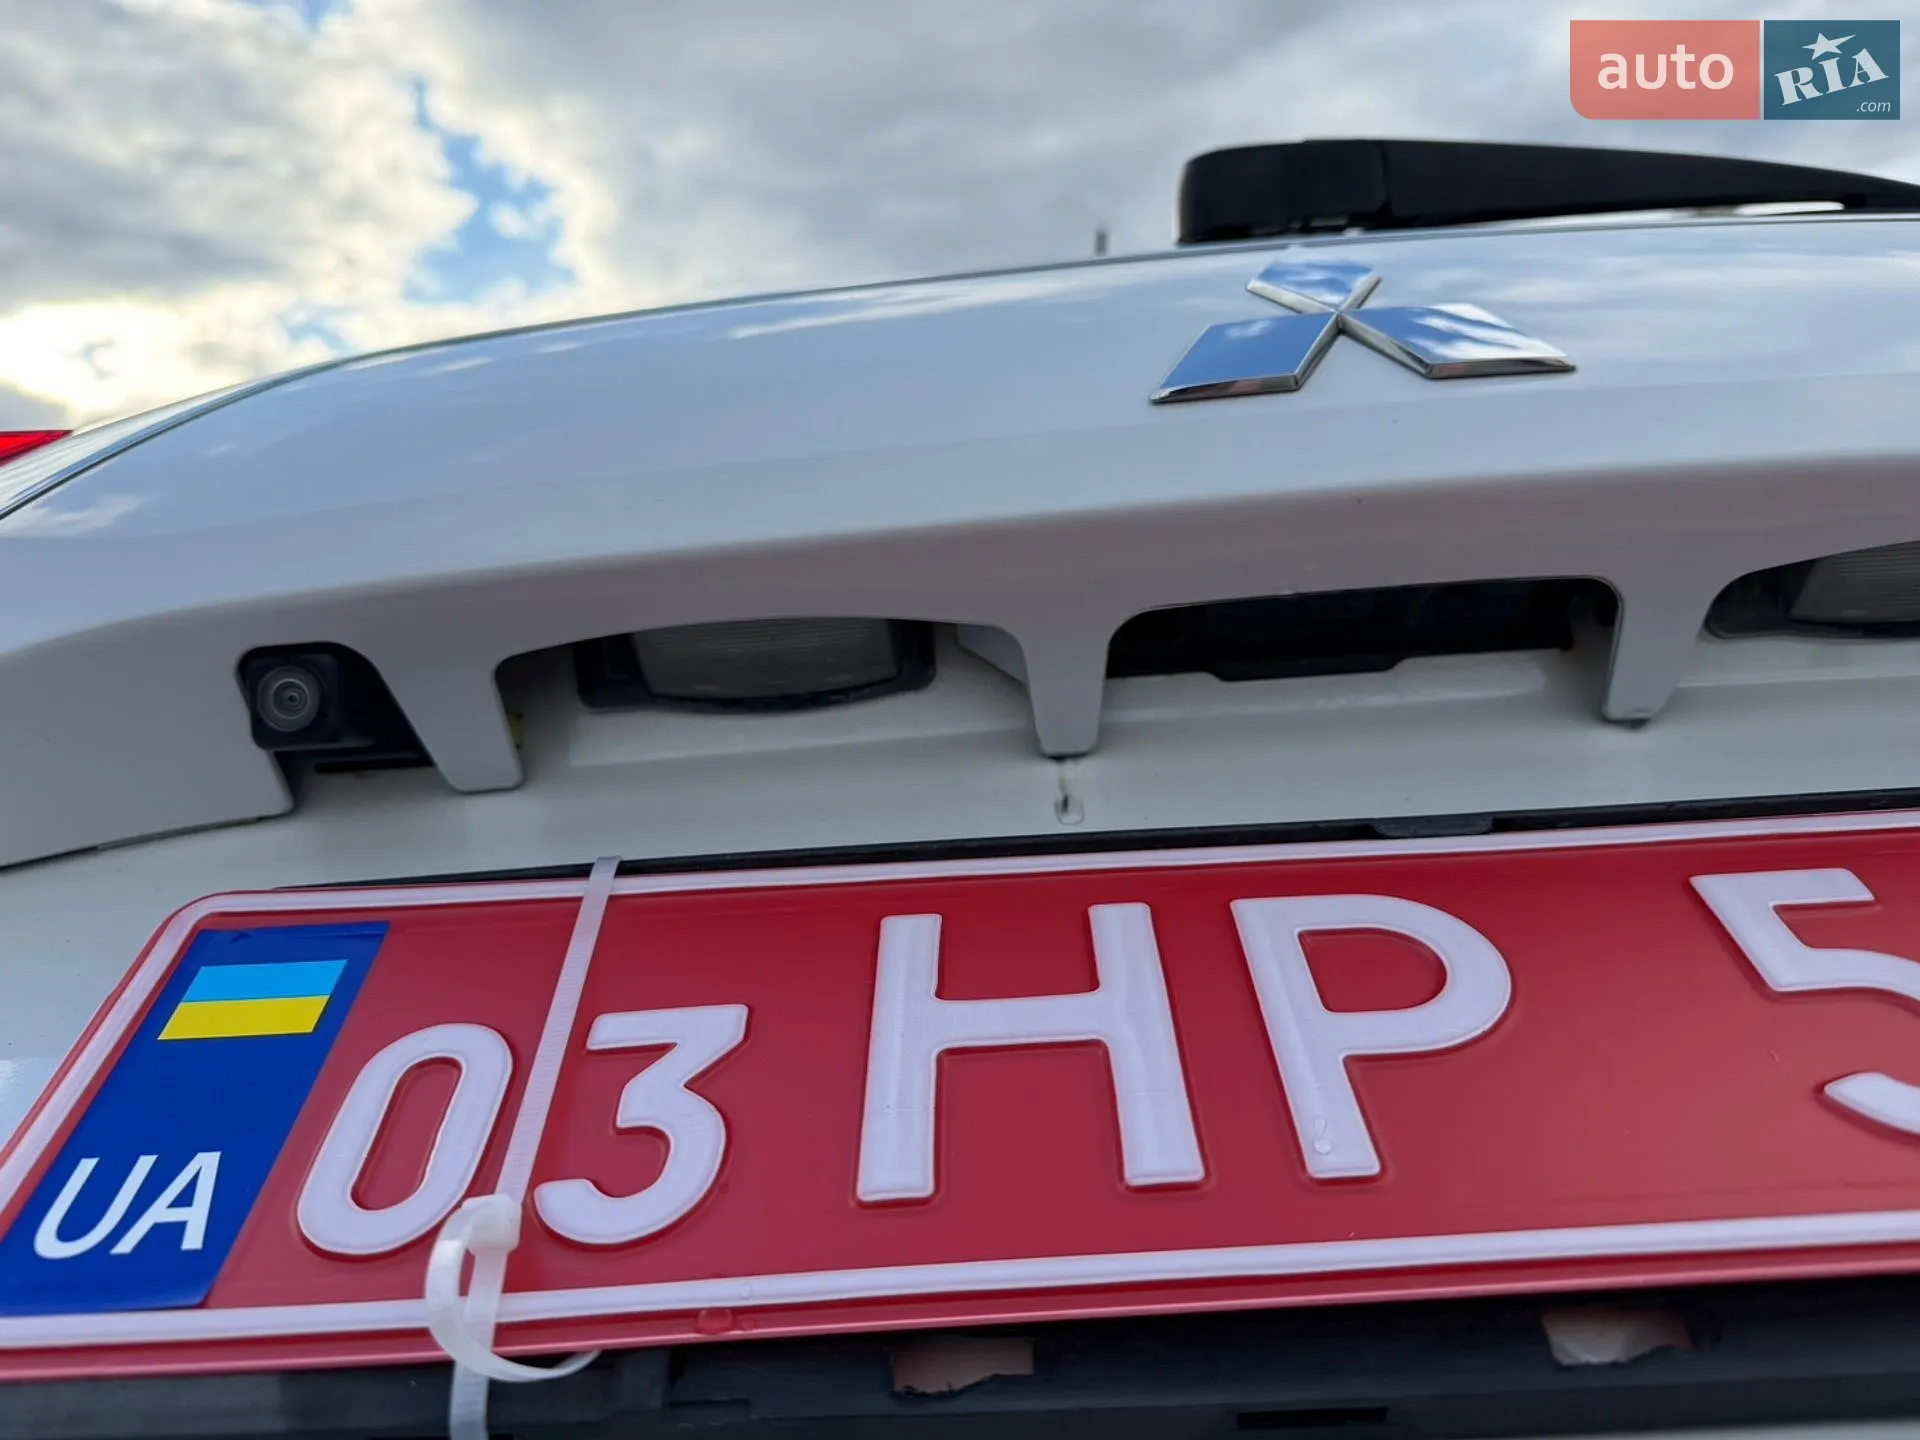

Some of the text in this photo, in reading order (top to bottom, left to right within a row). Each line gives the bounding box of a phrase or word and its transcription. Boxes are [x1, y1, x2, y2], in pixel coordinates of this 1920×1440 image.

[298, 1004, 748, 1255] 03
[856, 894, 1512, 1202] HP
[33, 1152, 221, 1259] UA
